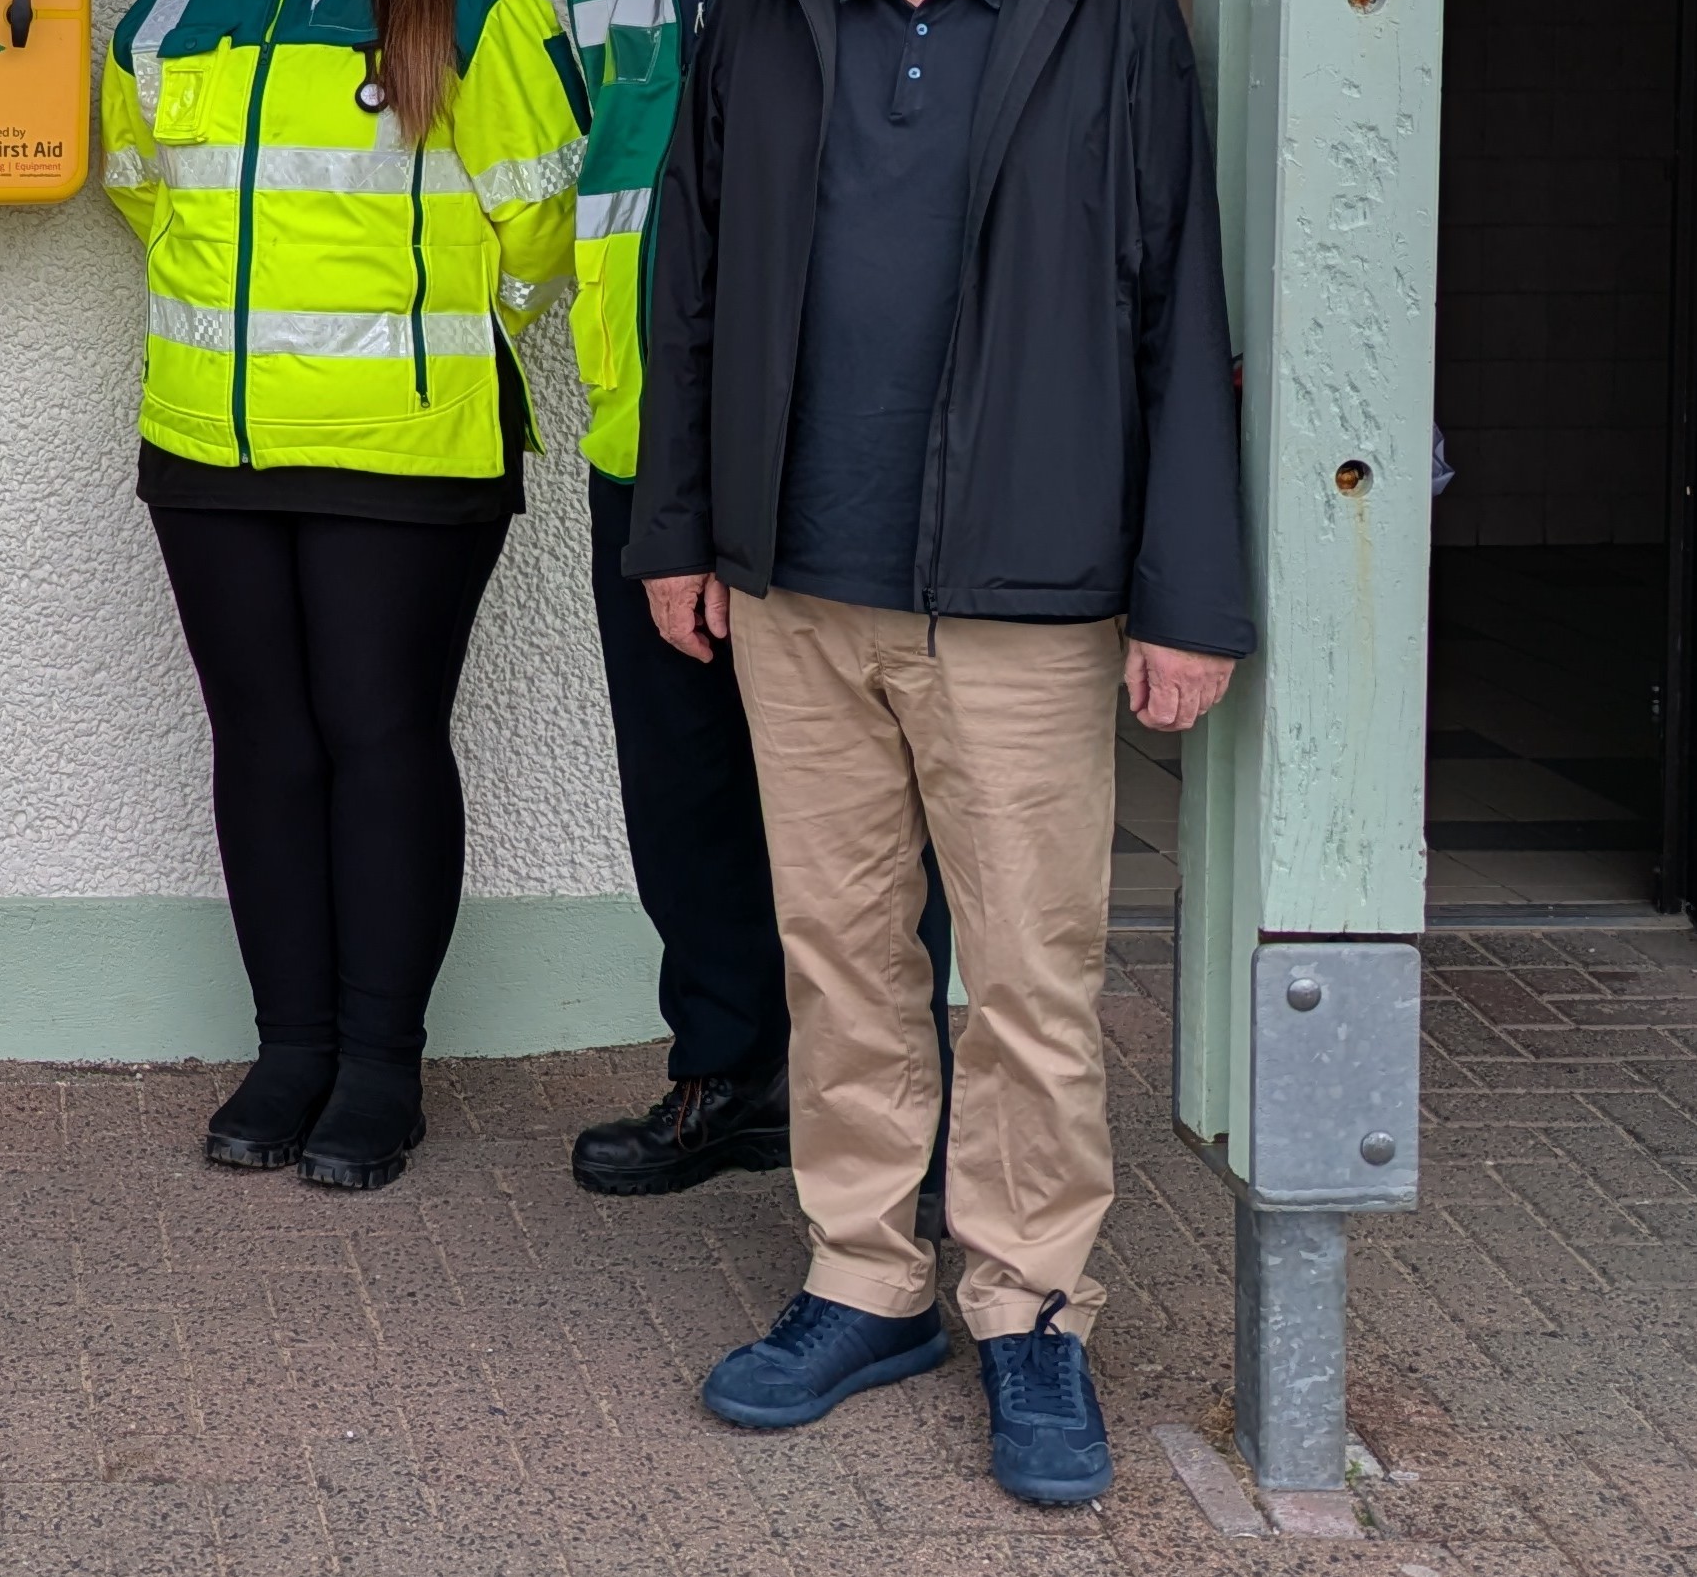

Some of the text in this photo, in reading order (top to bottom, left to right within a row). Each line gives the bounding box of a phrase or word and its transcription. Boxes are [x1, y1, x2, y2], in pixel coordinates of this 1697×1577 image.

[12, 126, 26, 140] by
[33, 141, 63, 158] Aid
[15, 162, 62, 172] Equipment
